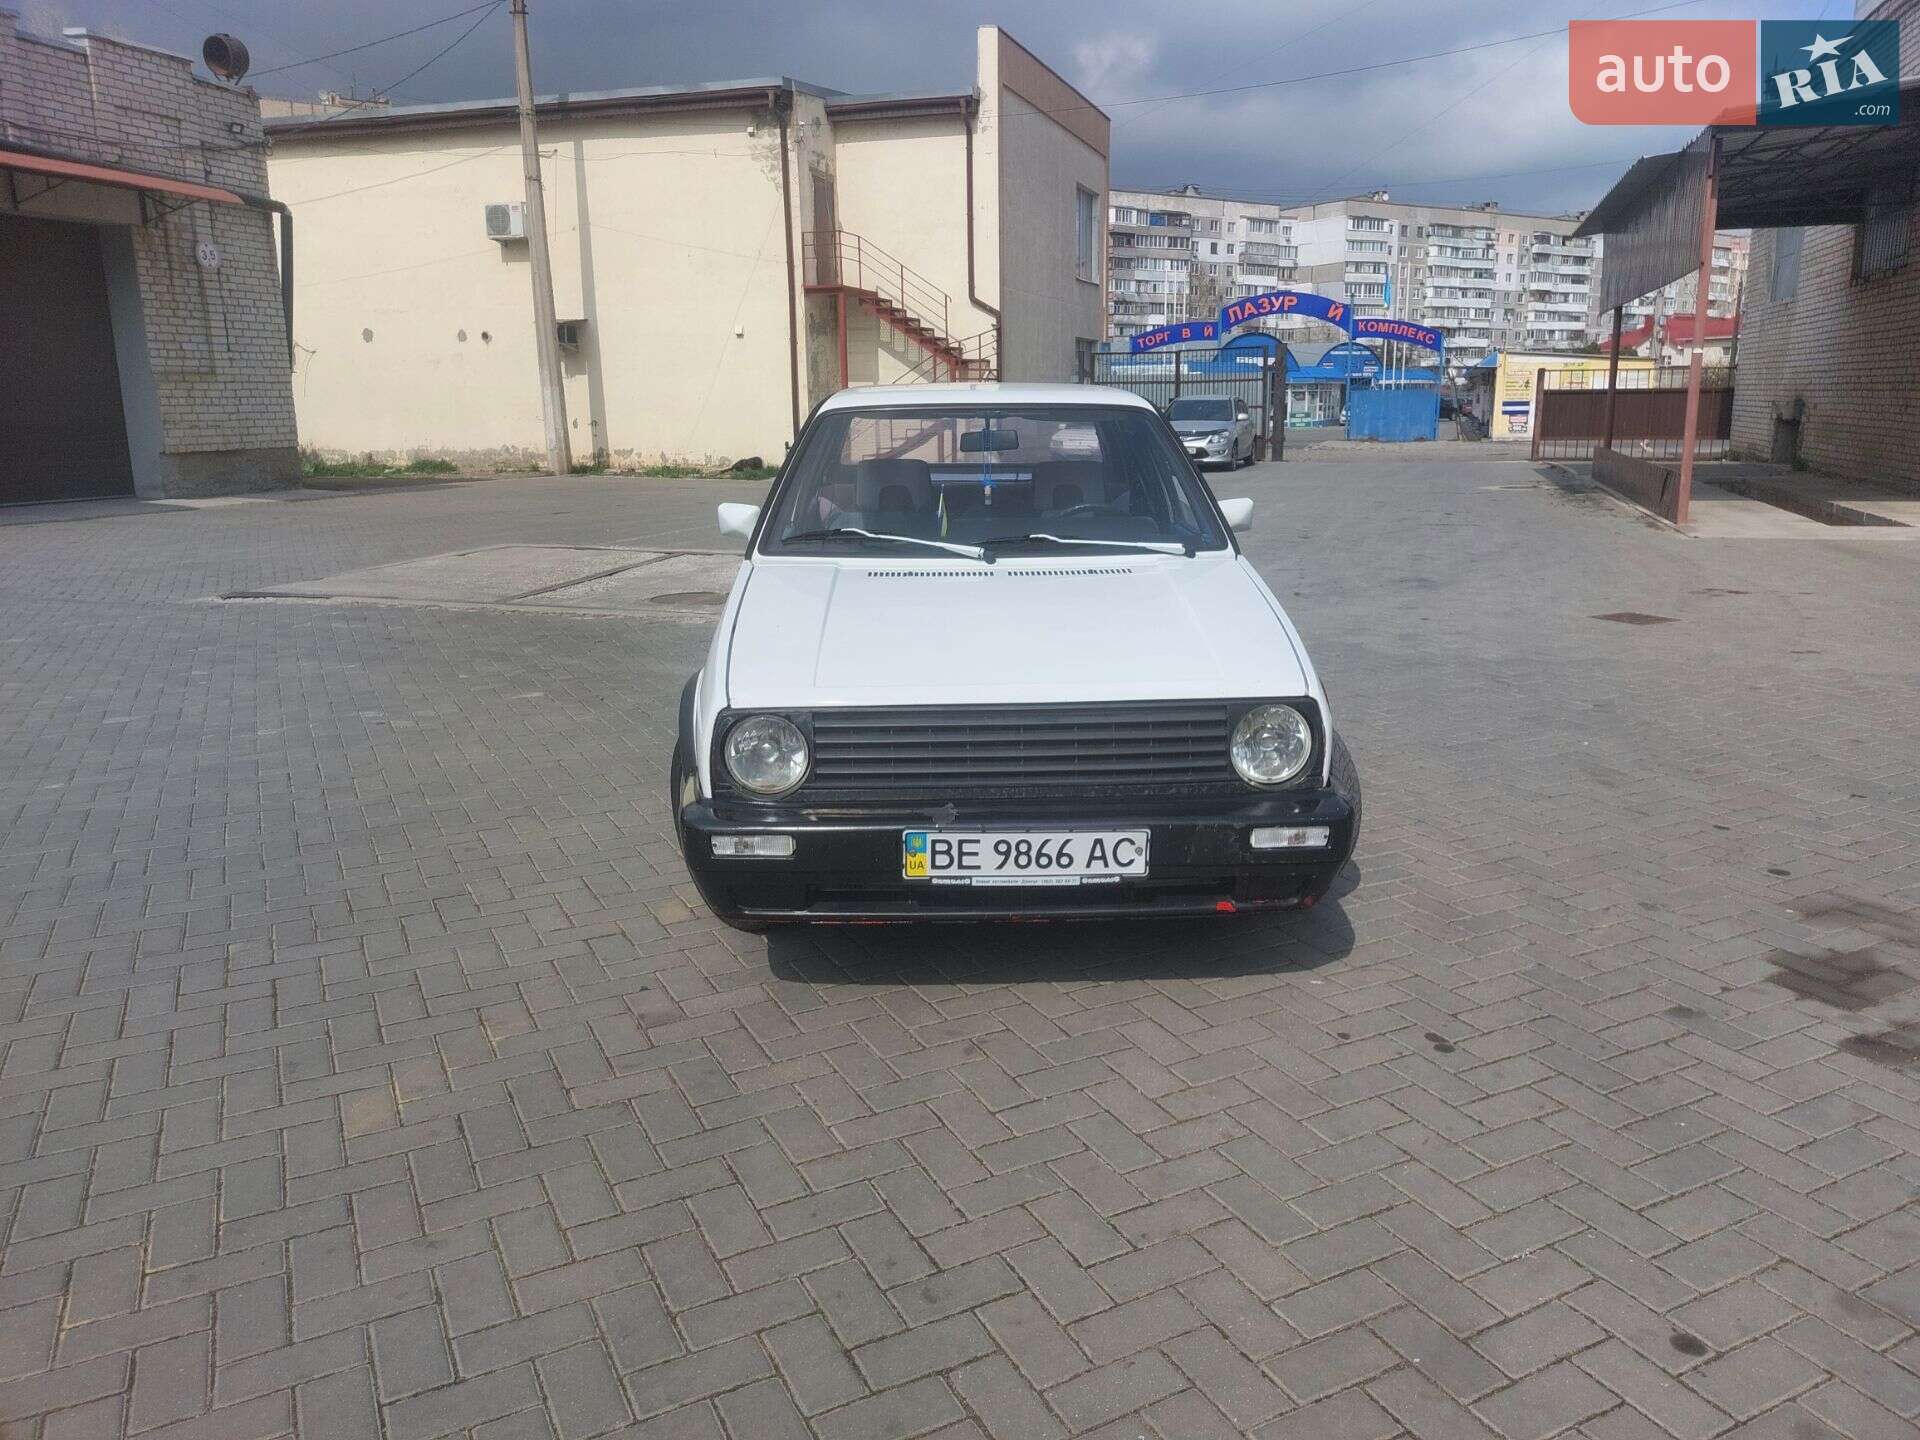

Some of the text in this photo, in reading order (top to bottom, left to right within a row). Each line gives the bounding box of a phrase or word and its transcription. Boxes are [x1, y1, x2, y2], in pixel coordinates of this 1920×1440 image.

[1358, 320, 1436, 345] КОМПЛЕКС
[909, 860, 925, 871] UA
[930, 837, 1137, 870] BE 9866 AC
